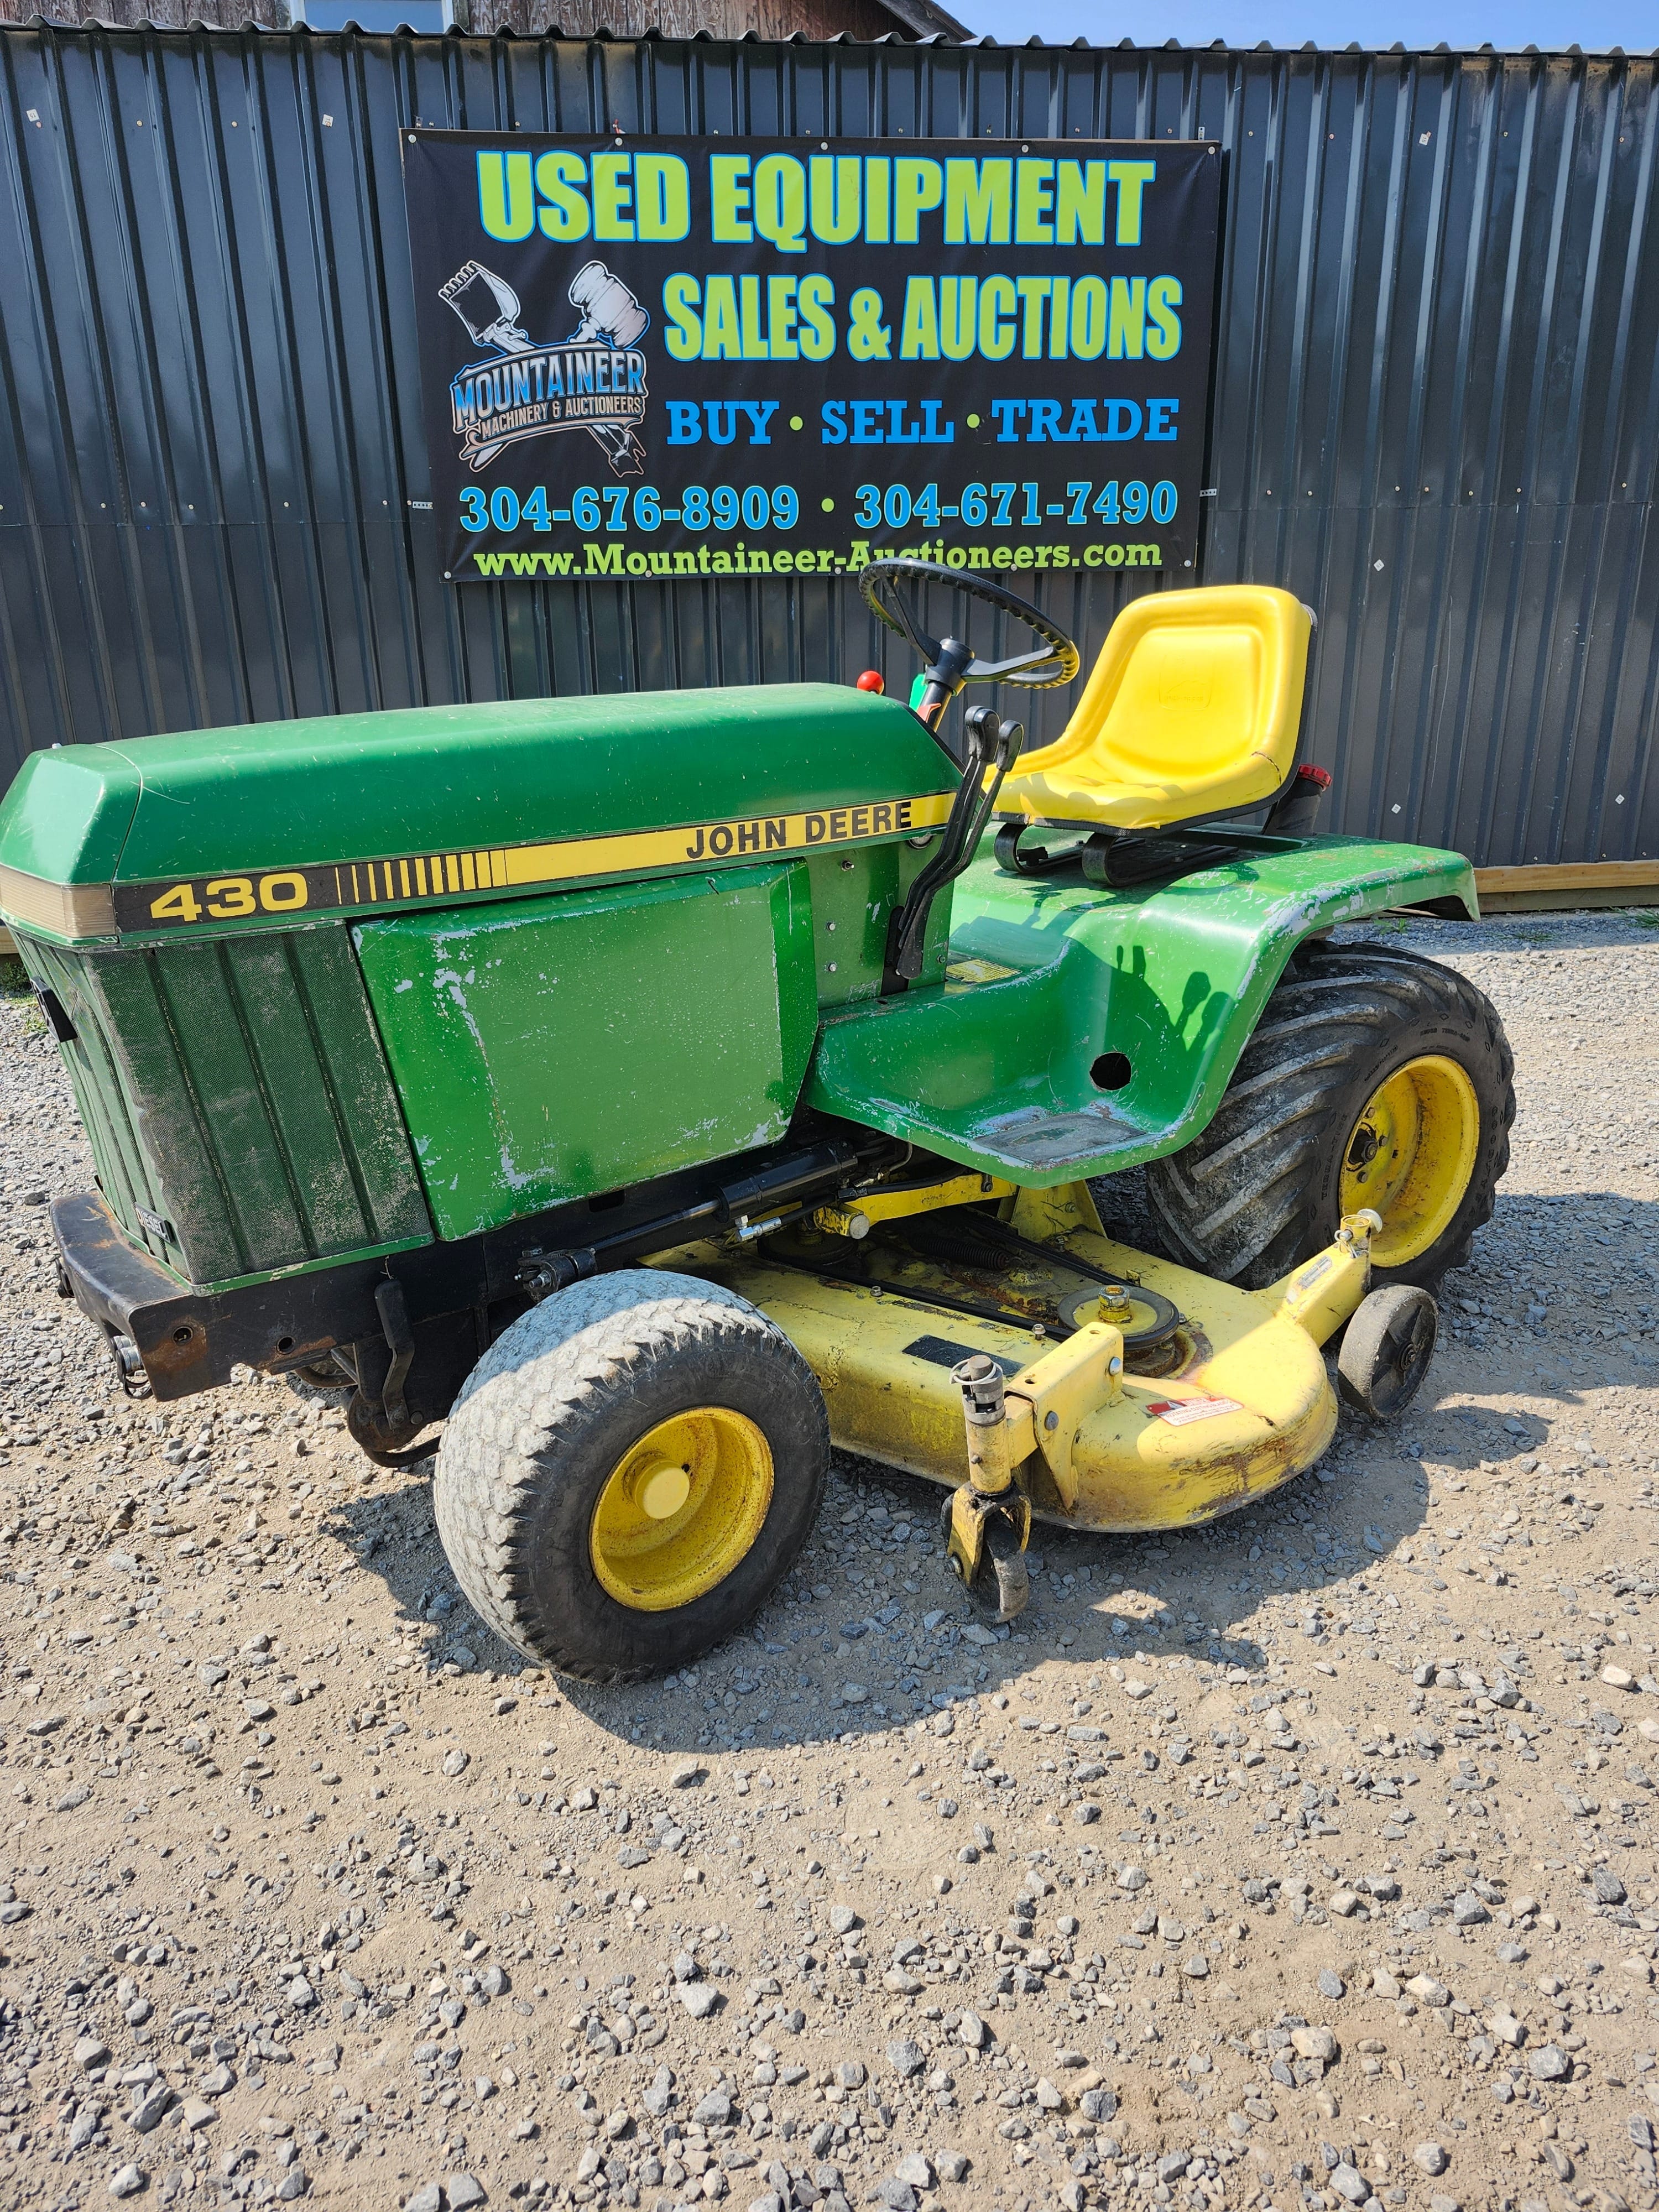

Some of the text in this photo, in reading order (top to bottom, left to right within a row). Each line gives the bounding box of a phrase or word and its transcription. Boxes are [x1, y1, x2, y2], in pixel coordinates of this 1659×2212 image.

[476, 149, 1157, 254] USED EQUIPMENT
[662, 272, 1183, 362] SALES & AUCTIONS
[452, 351, 648, 430] MOUNTAINEER
[481, 395, 644, 440] MACHINERY & AUCTIONEERS
[665, 398, 1180, 445] BUY SELL TRADE
[460, 481, 1178, 531] 304-676-8909 304-671-7490
[686, 801, 912, 860] JOHN DEERE
[150, 872, 308, 922] 430
[135, 1207, 171, 1244] DIESEL
